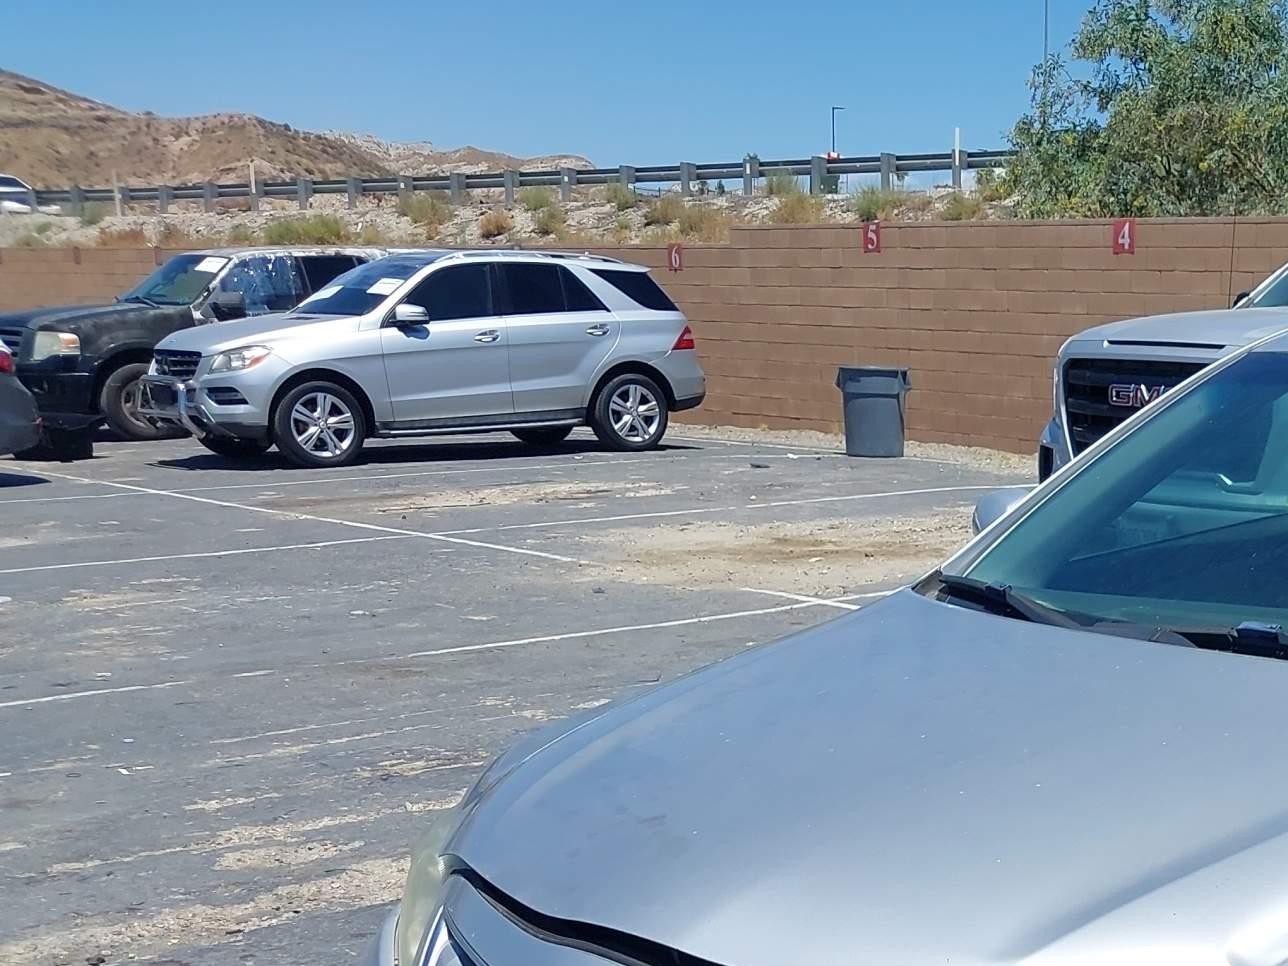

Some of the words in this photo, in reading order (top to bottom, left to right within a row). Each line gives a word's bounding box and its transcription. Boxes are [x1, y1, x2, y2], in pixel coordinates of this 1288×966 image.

[868, 224, 877, 249] 5
[1118, 222, 1130, 249] 4
[672, 246, 680, 268] 6
[1108, 384, 1174, 407] GM
